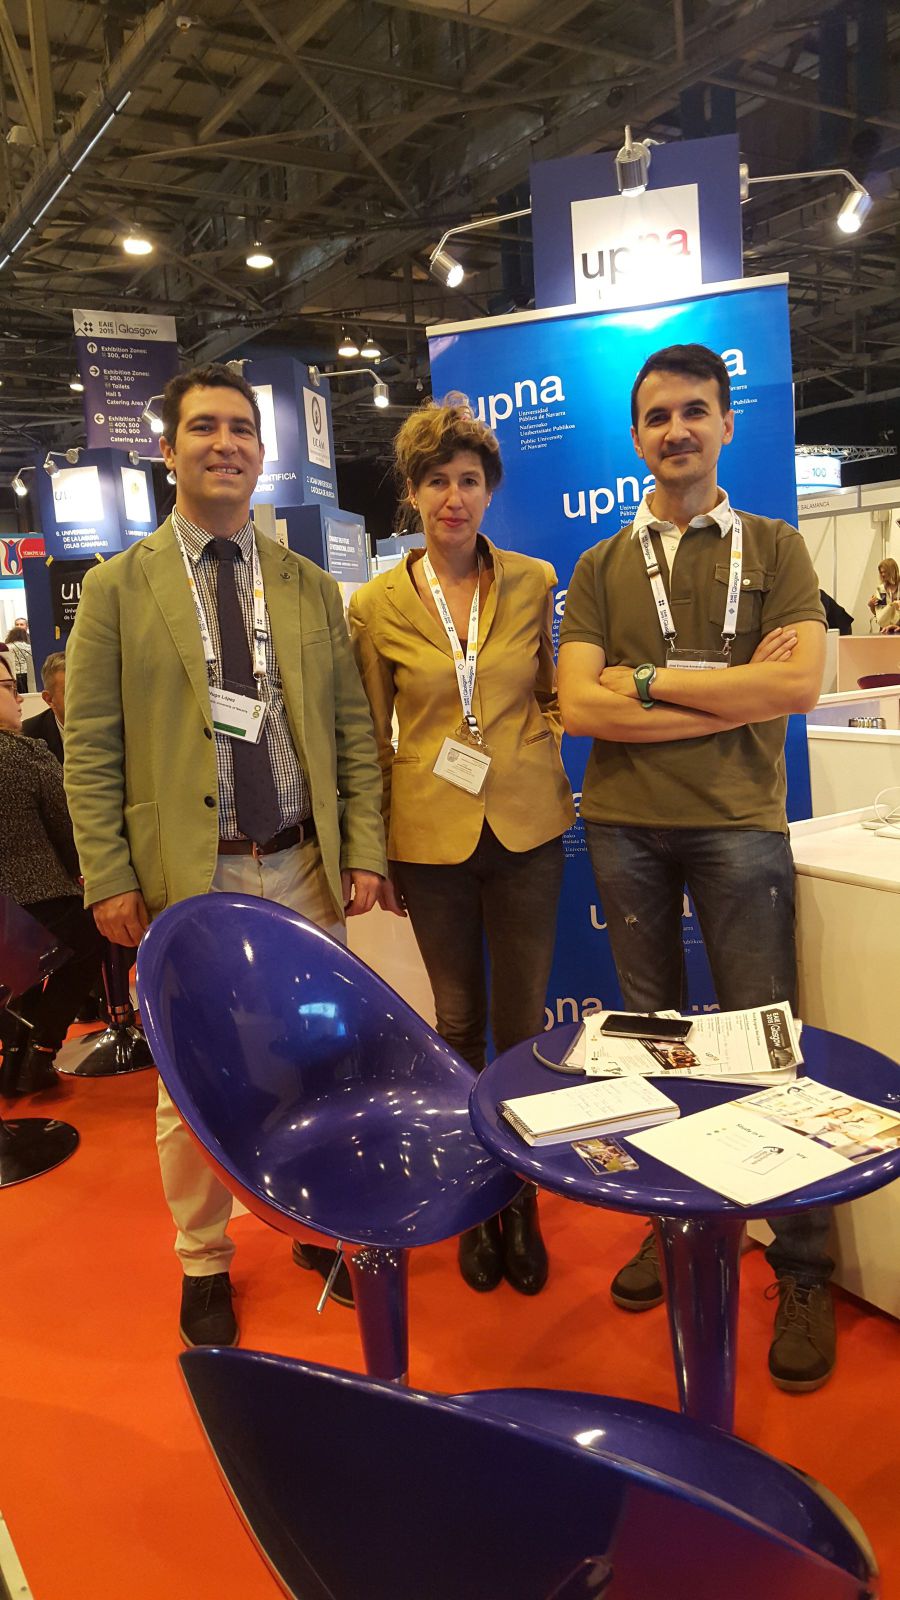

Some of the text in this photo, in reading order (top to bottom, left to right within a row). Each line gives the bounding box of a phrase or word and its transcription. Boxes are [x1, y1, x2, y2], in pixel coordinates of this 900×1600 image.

[118, 324, 159, 336] Glasgow
[518, 407, 548, 416] Universidad
[518, 414, 537, 422] Pública
[520, 422, 548, 430] Nafarroako
[537, 434, 563, 443] University
[800, 502, 830, 510] SALAMANCA
[769, 1024, 781, 1047] Glasgow
